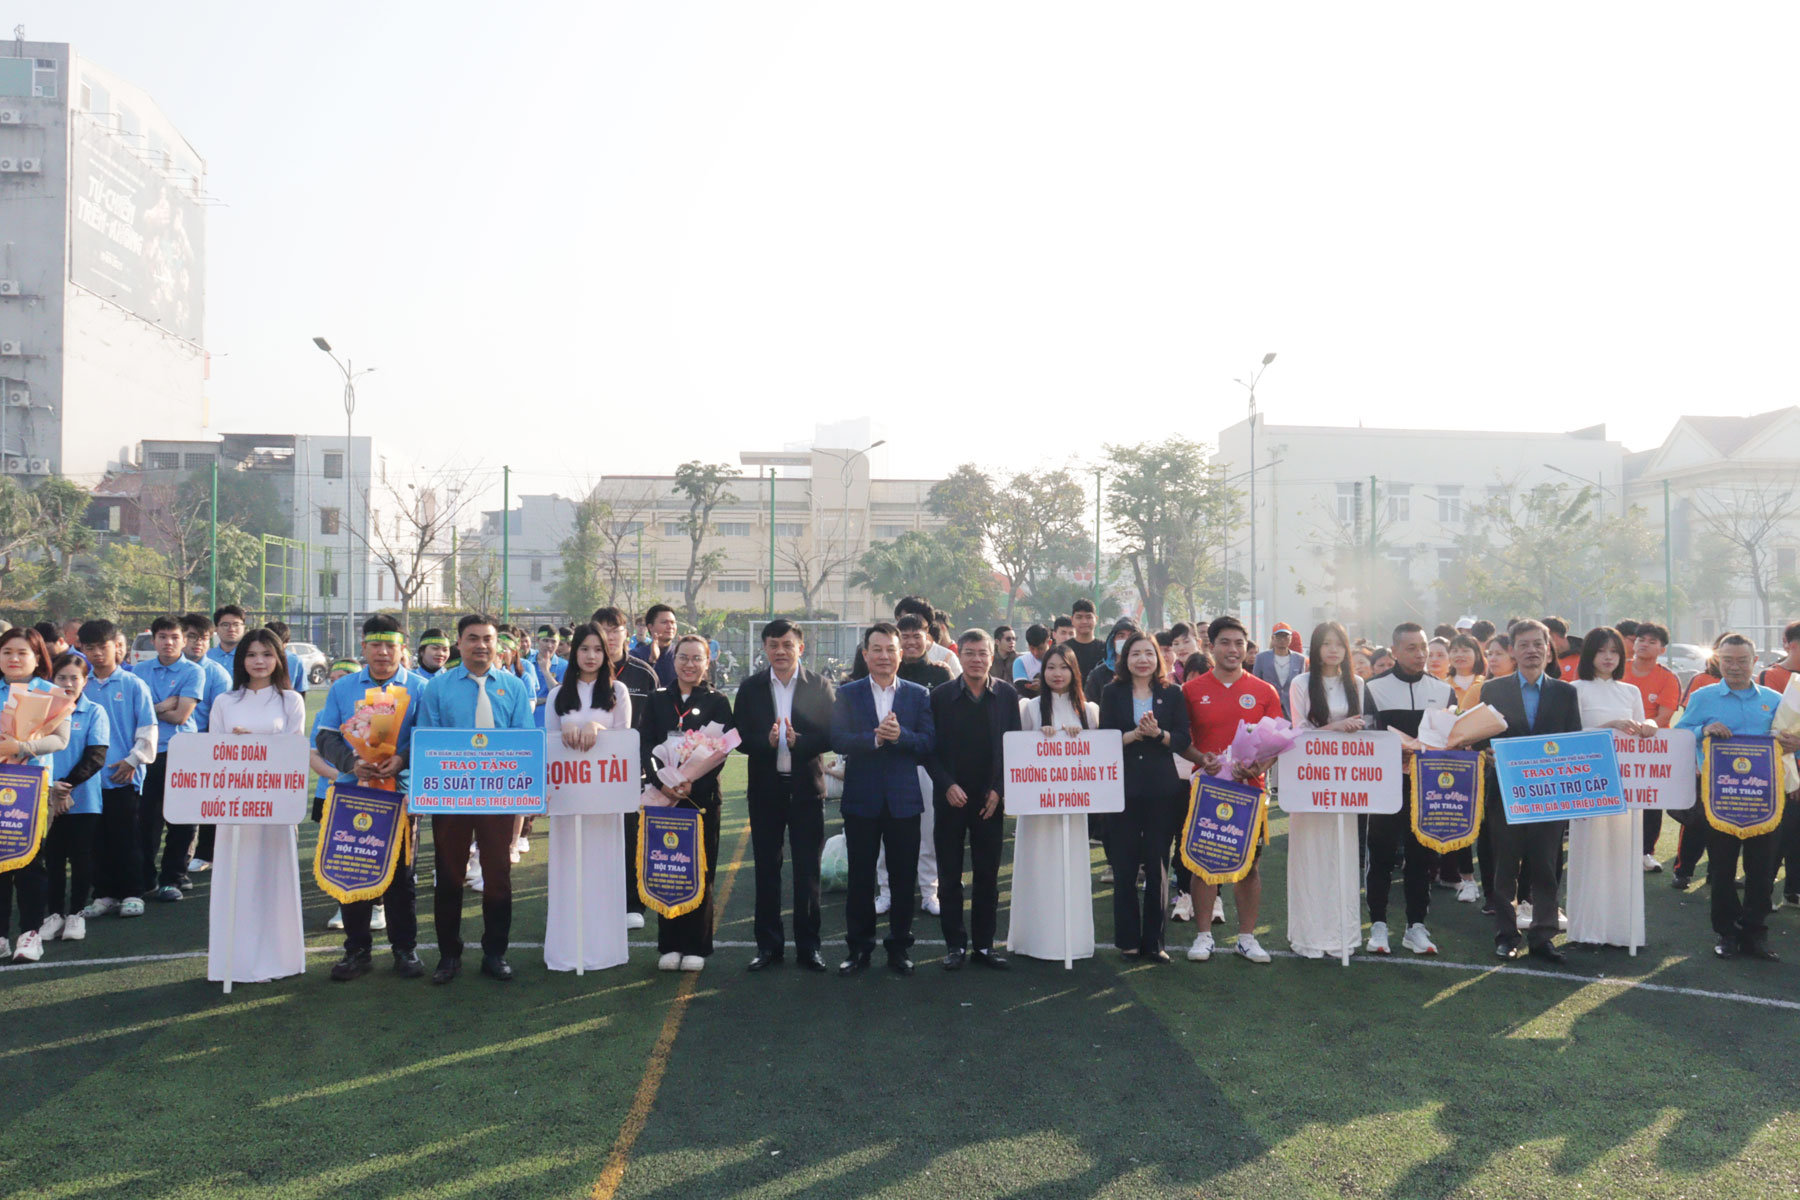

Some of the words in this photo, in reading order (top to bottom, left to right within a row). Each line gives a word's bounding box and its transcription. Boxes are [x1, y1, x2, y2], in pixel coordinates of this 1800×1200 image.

[213, 742, 238, 760] CÔNG
[242, 742, 267, 761] ĐOÀN
[1037, 739, 1062, 756] CÔNG
[1065, 738, 1090, 756] ĐOÀN
[1306, 738, 1338, 755] CÔNG
[1342, 739, 1374, 756] ĐOÀN
[1614, 736, 1635, 753] ÔNG
[1638, 736, 1668, 753] ĐOÀN
[440, 761, 477, 770] TRAO
[480, 759, 518, 772] TẶNG
[547, 760, 591, 790] ỌNG
[598, 754, 627, 782] TÀI
[1010, 764, 1047, 783] TRƯỜNG
[1050, 767, 1068, 782] CAO
[1099, 766, 1104, 780] Y
[1107, 761, 1118, 780] TẾ
[1298, 763, 1330, 780] CÔNG
[1334, 766, 1347, 781] TY
[1351, 766, 1382, 781] CHUO
[1522, 768, 1554, 778] TRAO
[1558, 764, 1591, 776] TẶNG
[1634, 764, 1646, 778] TY
[1650, 764, 1672, 778] MAY
[171, 769, 197, 788] CÔNG
[200, 772, 211, 788] TY
[256, 770, 281, 792] BỆNH
[284, 770, 305, 793] VIỆN
[423, 777, 439, 790] 85
[444, 772, 475, 790] SUẤT
[480, 776, 505, 792] TRỢ
[508, 771, 533, 790] CẤP
[1512, 786, 1525, 798] 90
[1529, 780, 1557, 797] SUẤT
[1560, 780, 1582, 796] TRỢ
[1586, 775, 1608, 791] CẤP
[1040, 788, 1056, 808] HẢI
[1059, 789, 1090, 807] PHÒNG
[1312, 788, 1337, 809] VIỆT
[1341, 792, 1368, 807] NAM
[1636, 786, 1658, 806] VIỆT
[1722, 786, 1737, 795] HỘI
[201, 796, 226, 818] QUỐC
[229, 796, 240, 816] TẾ
[242, 801, 272, 817] GREEN
[441, 796, 456, 808] TRỊ
[475, 796, 486, 806] 85
[489, 795, 513, 808] TRIỆU
[516, 794, 541, 806] ĐỒNG
[1560, 801, 1570, 810] 90
[1201, 830, 1214, 839] HỘI
[1216, 834, 1238, 844] THAO
[336, 844, 352, 853] HỘI
[354, 847, 378, 856] THAO
[654, 863, 666, 872] HỘI
